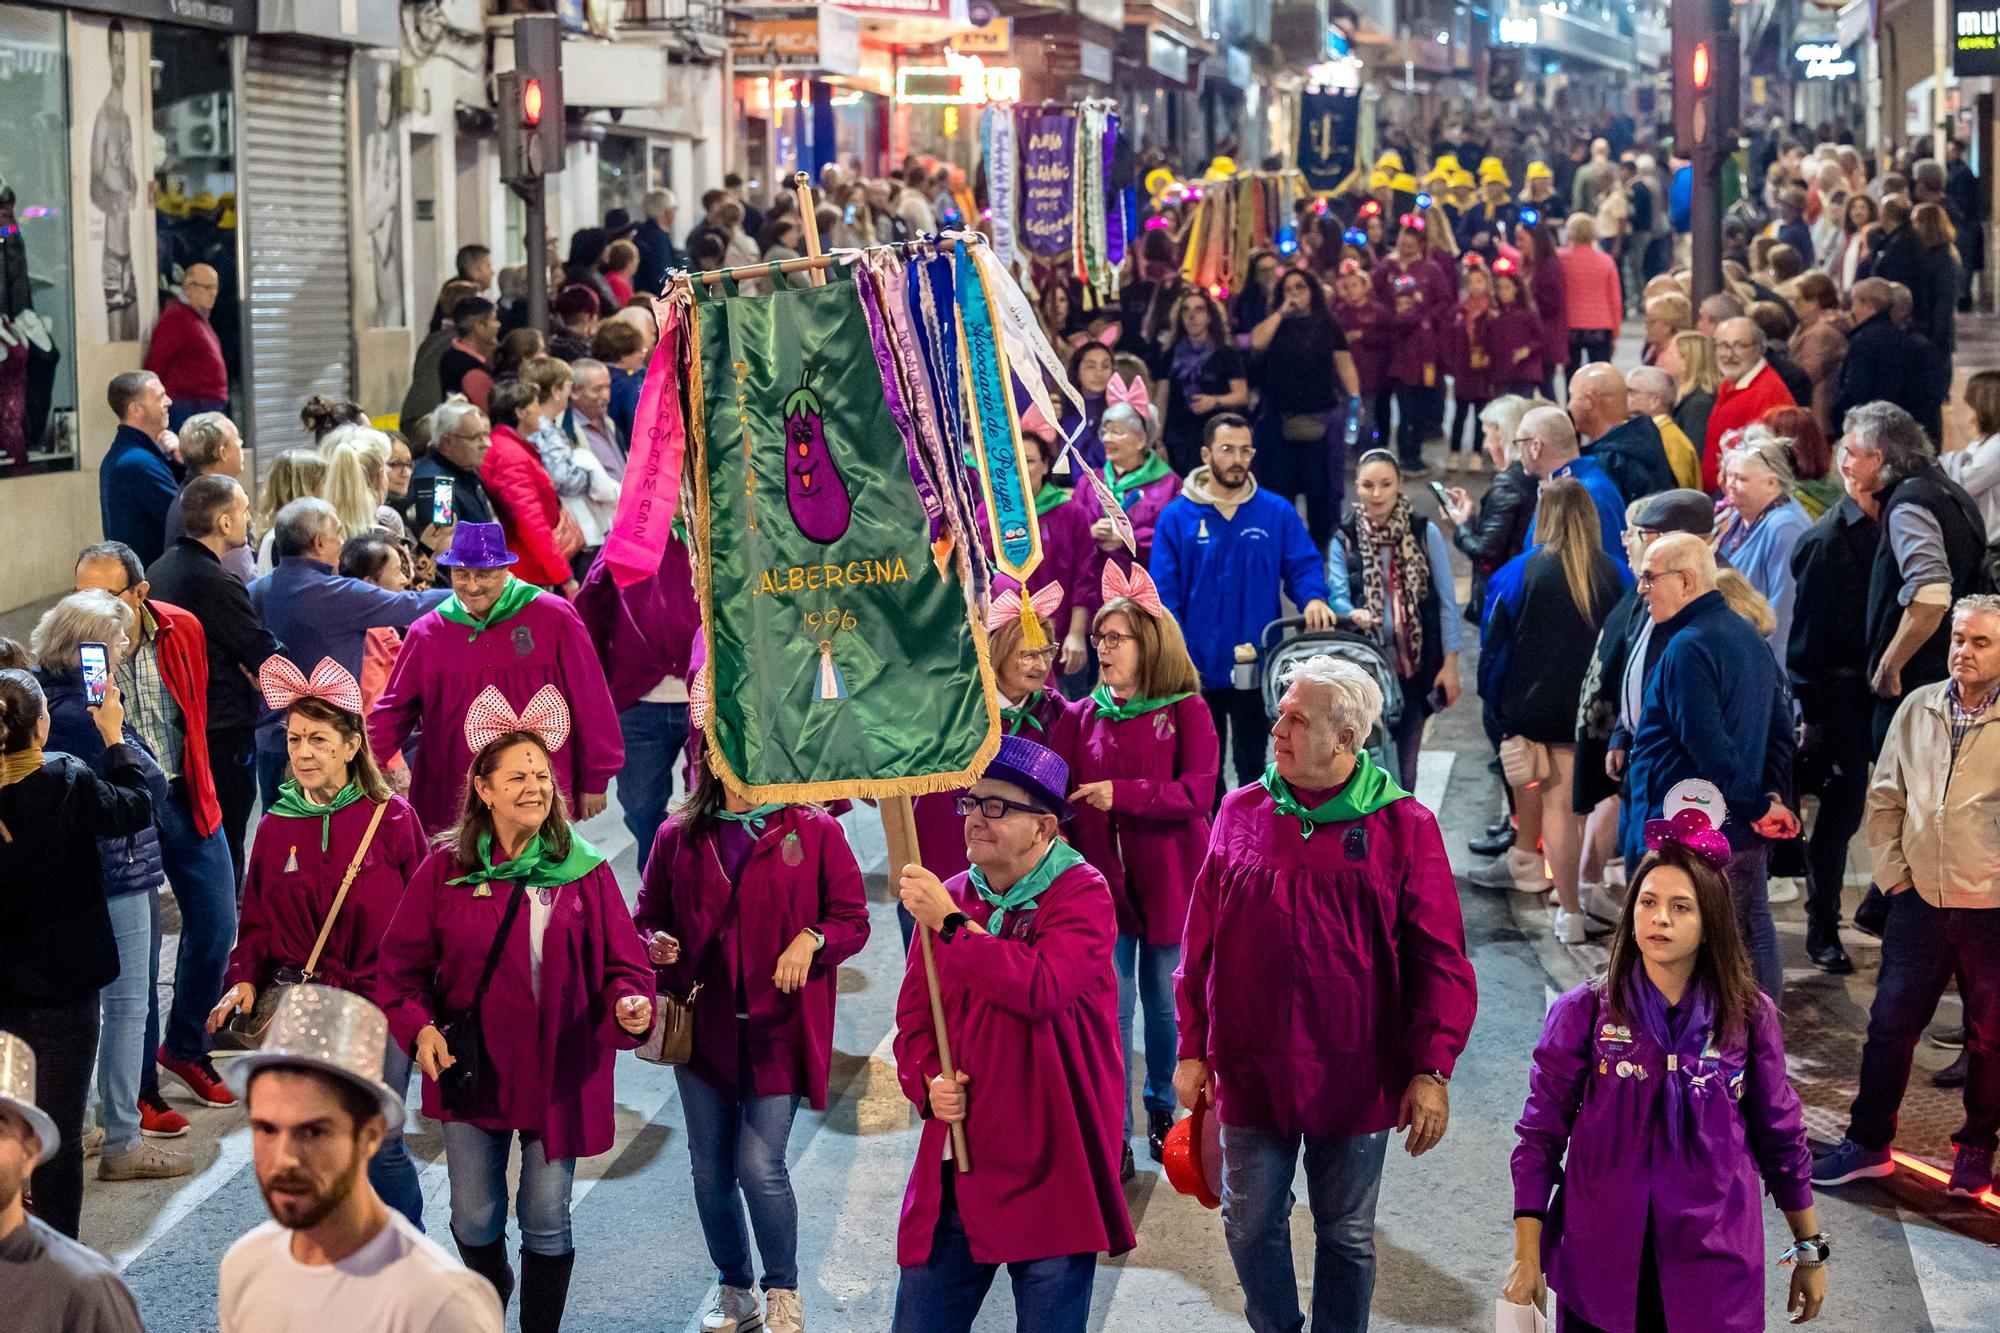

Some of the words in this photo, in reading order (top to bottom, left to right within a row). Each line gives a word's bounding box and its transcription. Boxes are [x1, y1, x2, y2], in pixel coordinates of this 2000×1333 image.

[1957, 8, 2000, 36] mu
[970, 321, 1001, 414] Associació
[988, 416, 1005, 439] de
[990, 447, 1016, 513] Penyes
[803, 608, 857, 635] 1996
